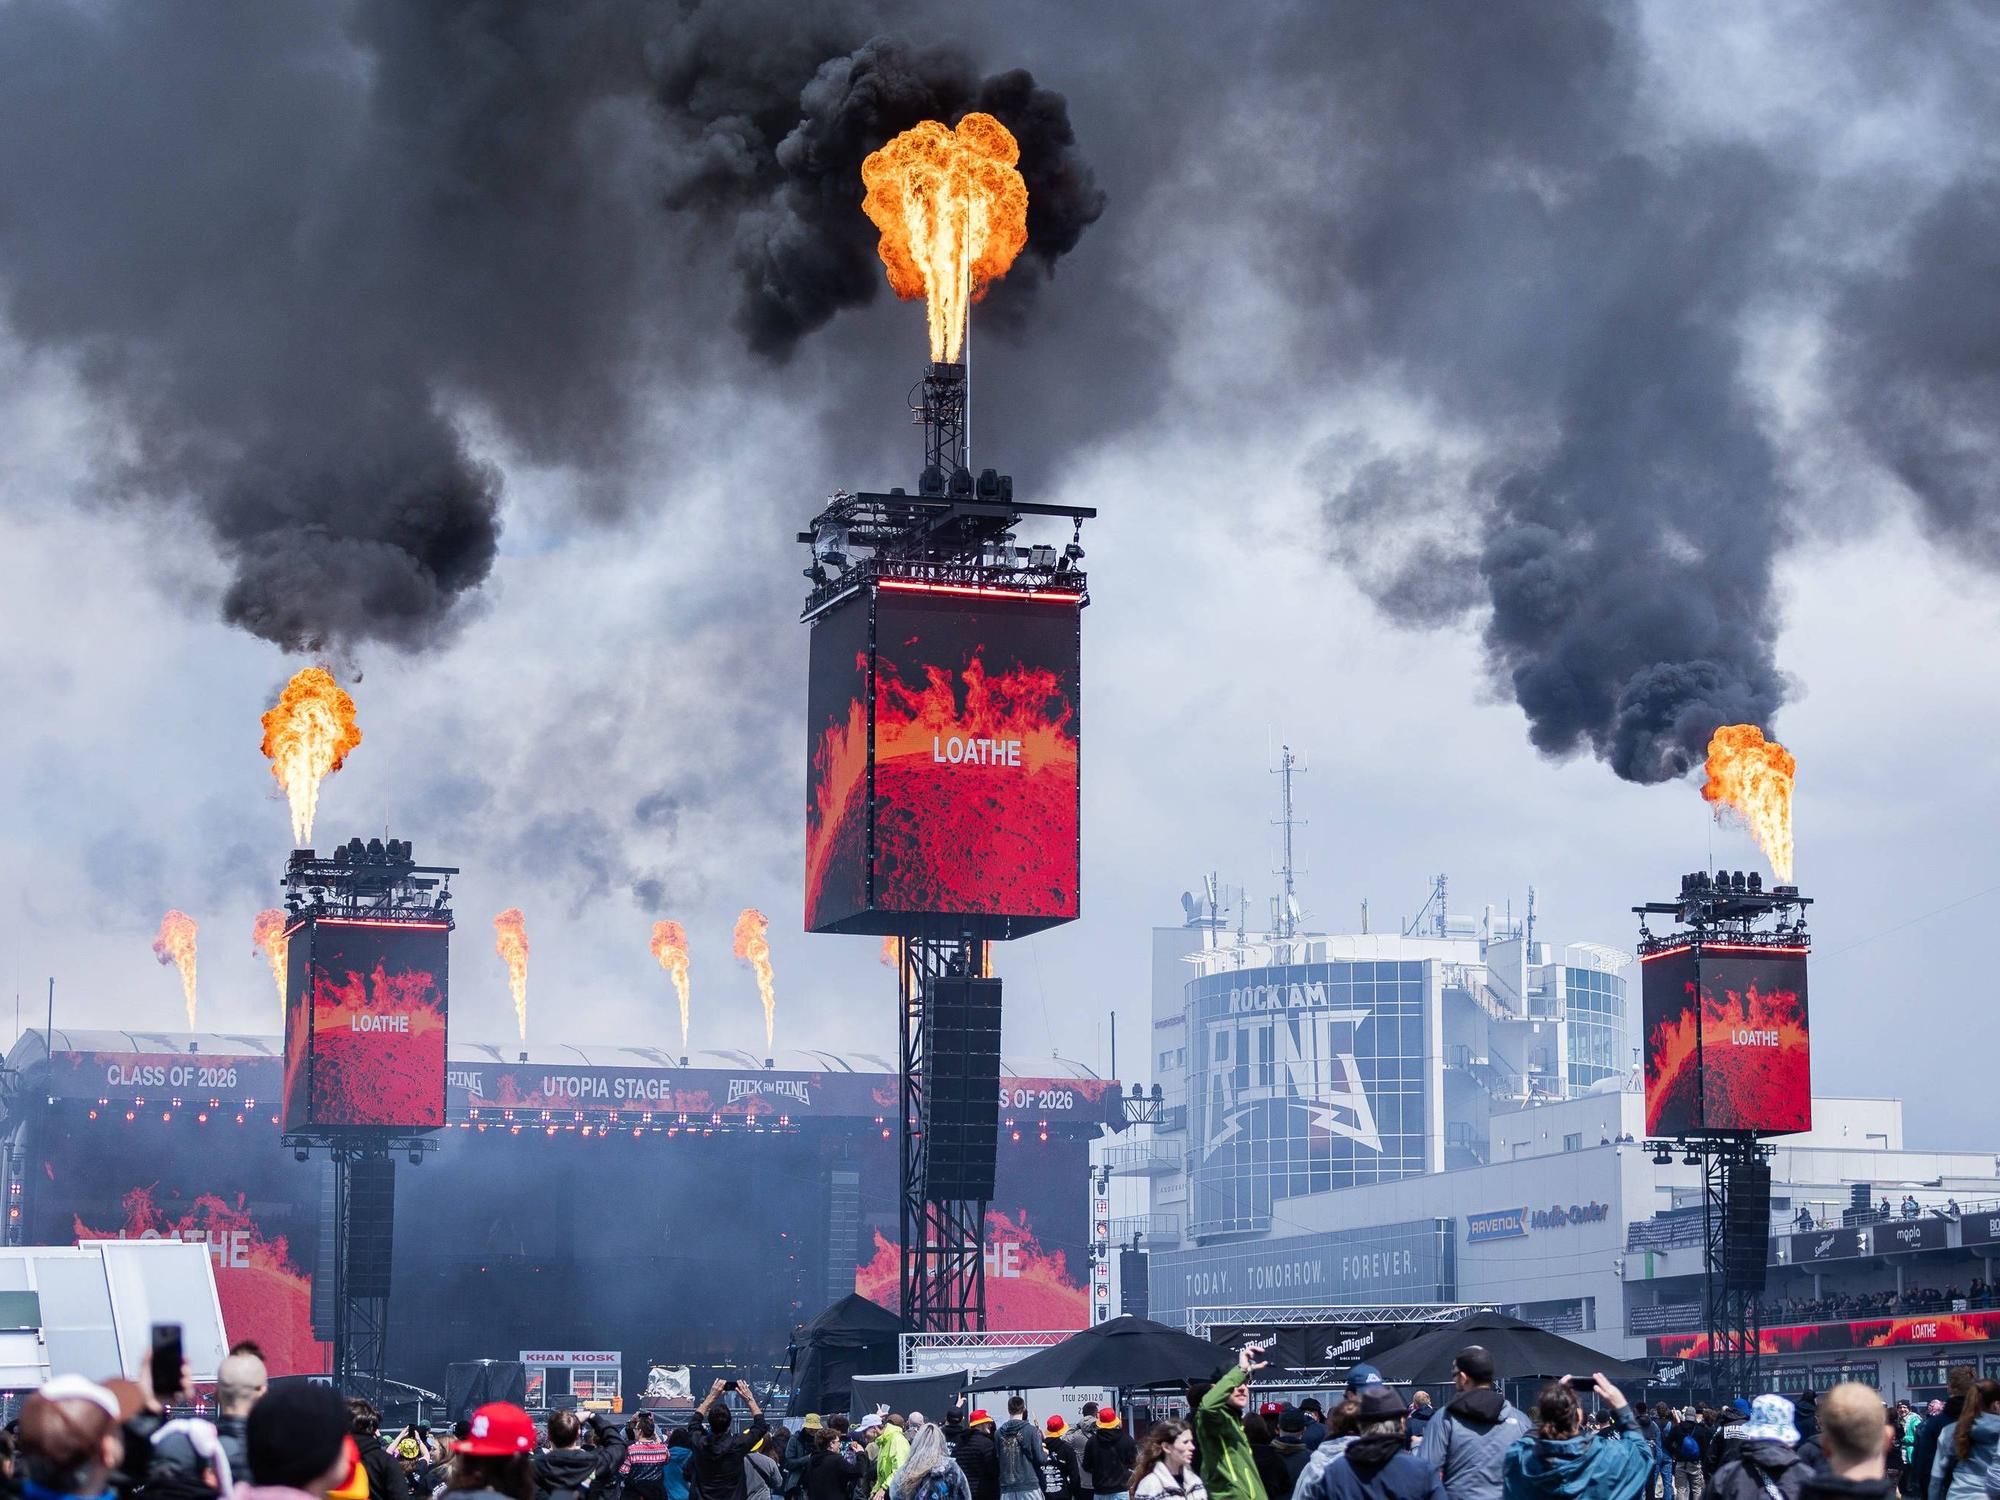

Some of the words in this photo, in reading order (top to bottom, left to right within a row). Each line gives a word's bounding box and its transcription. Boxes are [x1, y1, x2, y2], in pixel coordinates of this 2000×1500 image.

[933, 736, 1021, 767] LOATHE
[1229, 983, 1282, 1014] ROCK
[1289, 981, 1328, 1008] AM
[351, 1014, 410, 1034] LOATHE
[1732, 1029, 1779, 1047] LOATHE
[107, 1064, 166, 1087] CLASS
[169, 1067, 195, 1088] OF
[198, 1068, 238, 1089] 2026
[543, 1076, 610, 1099] UTOPIA
[613, 1077, 671, 1100] STAGE
[1203, 1009, 1384, 1163] RING
[727, 1079, 763, 1105] ROCK
[775, 1080, 811, 1106] RING
[1013, 1089, 1036, 1109] OF
[1038, 1091, 1073, 1110] 2026
[1471, 1216, 1519, 1235] RAVENOL
[1186, 1271, 1232, 1297] TODAY.
[1247, 1258, 1327, 1292] TOMORROW.
[1342, 1250, 1417, 1281] FOREVER.
[1911, 1323, 1937, 1339] LOATHE
[571, 1354, 615, 1362] KIOSK
